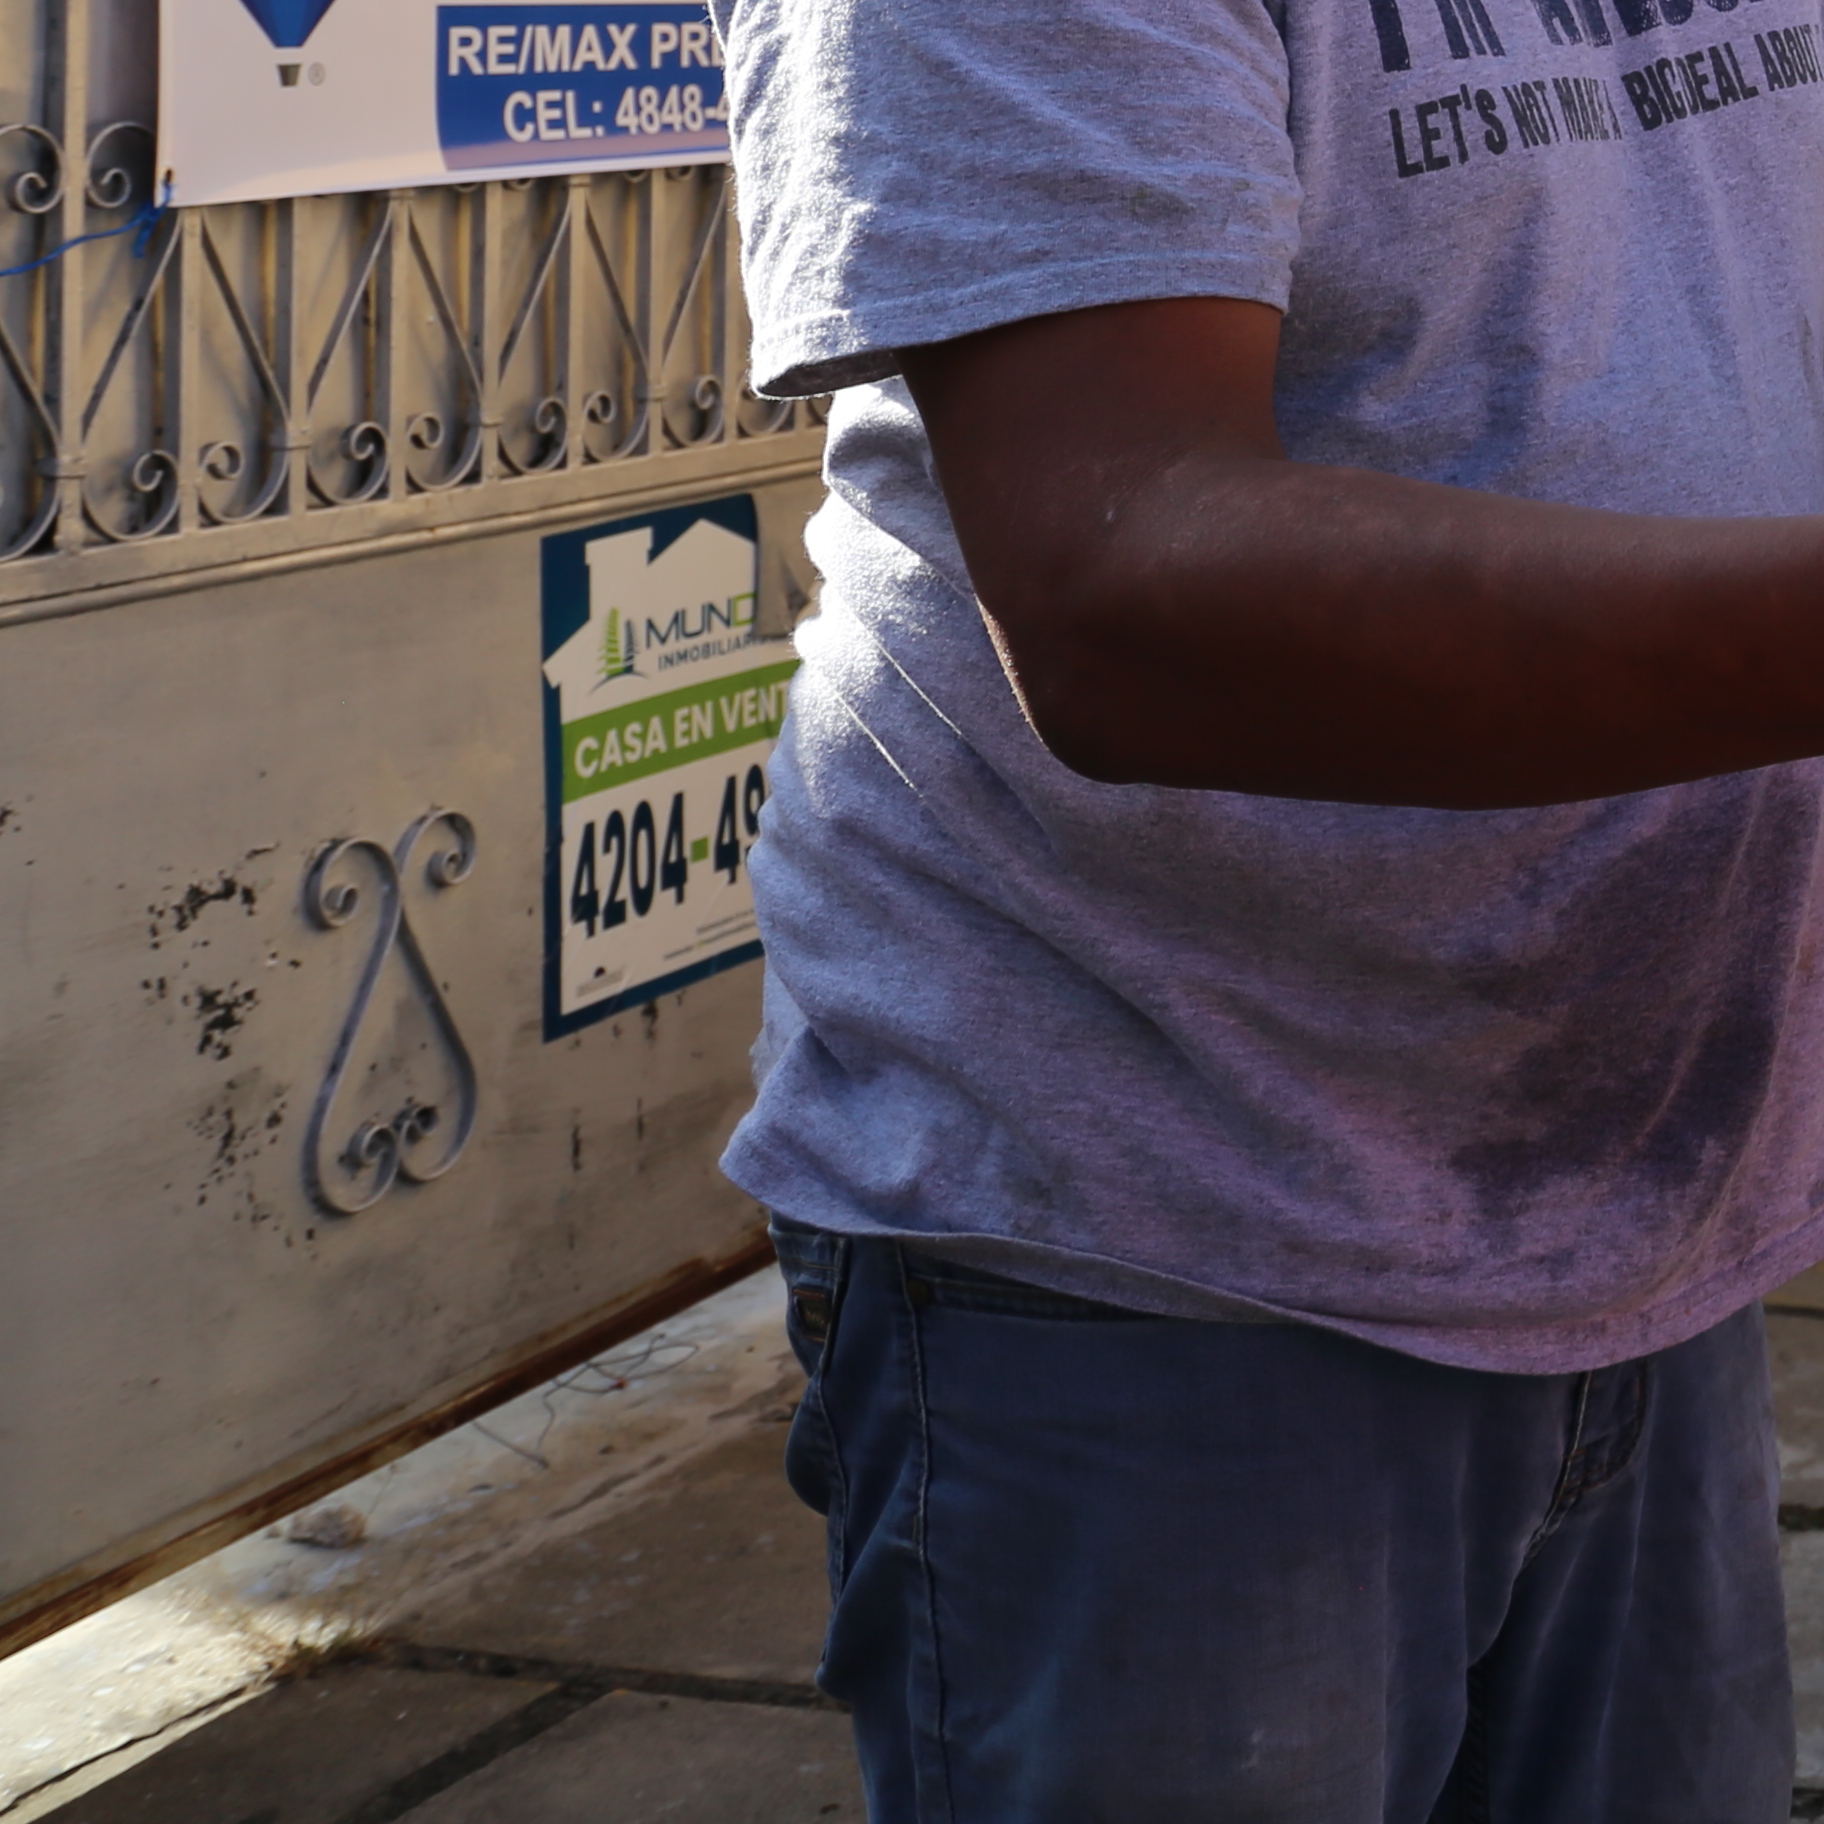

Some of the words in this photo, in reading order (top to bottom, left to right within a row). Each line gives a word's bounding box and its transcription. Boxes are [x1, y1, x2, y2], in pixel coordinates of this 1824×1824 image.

[448, 23, 638, 76] RE/MAX
[503, 90, 604, 143] CEL:
[1388, 83, 1508, 179] LET'S
[1502, 80, 1560, 149] NOT
[1621, 57, 1689, 132] BIG
[573, 715, 668, 779] CASA
[673, 700, 715, 749] EN
